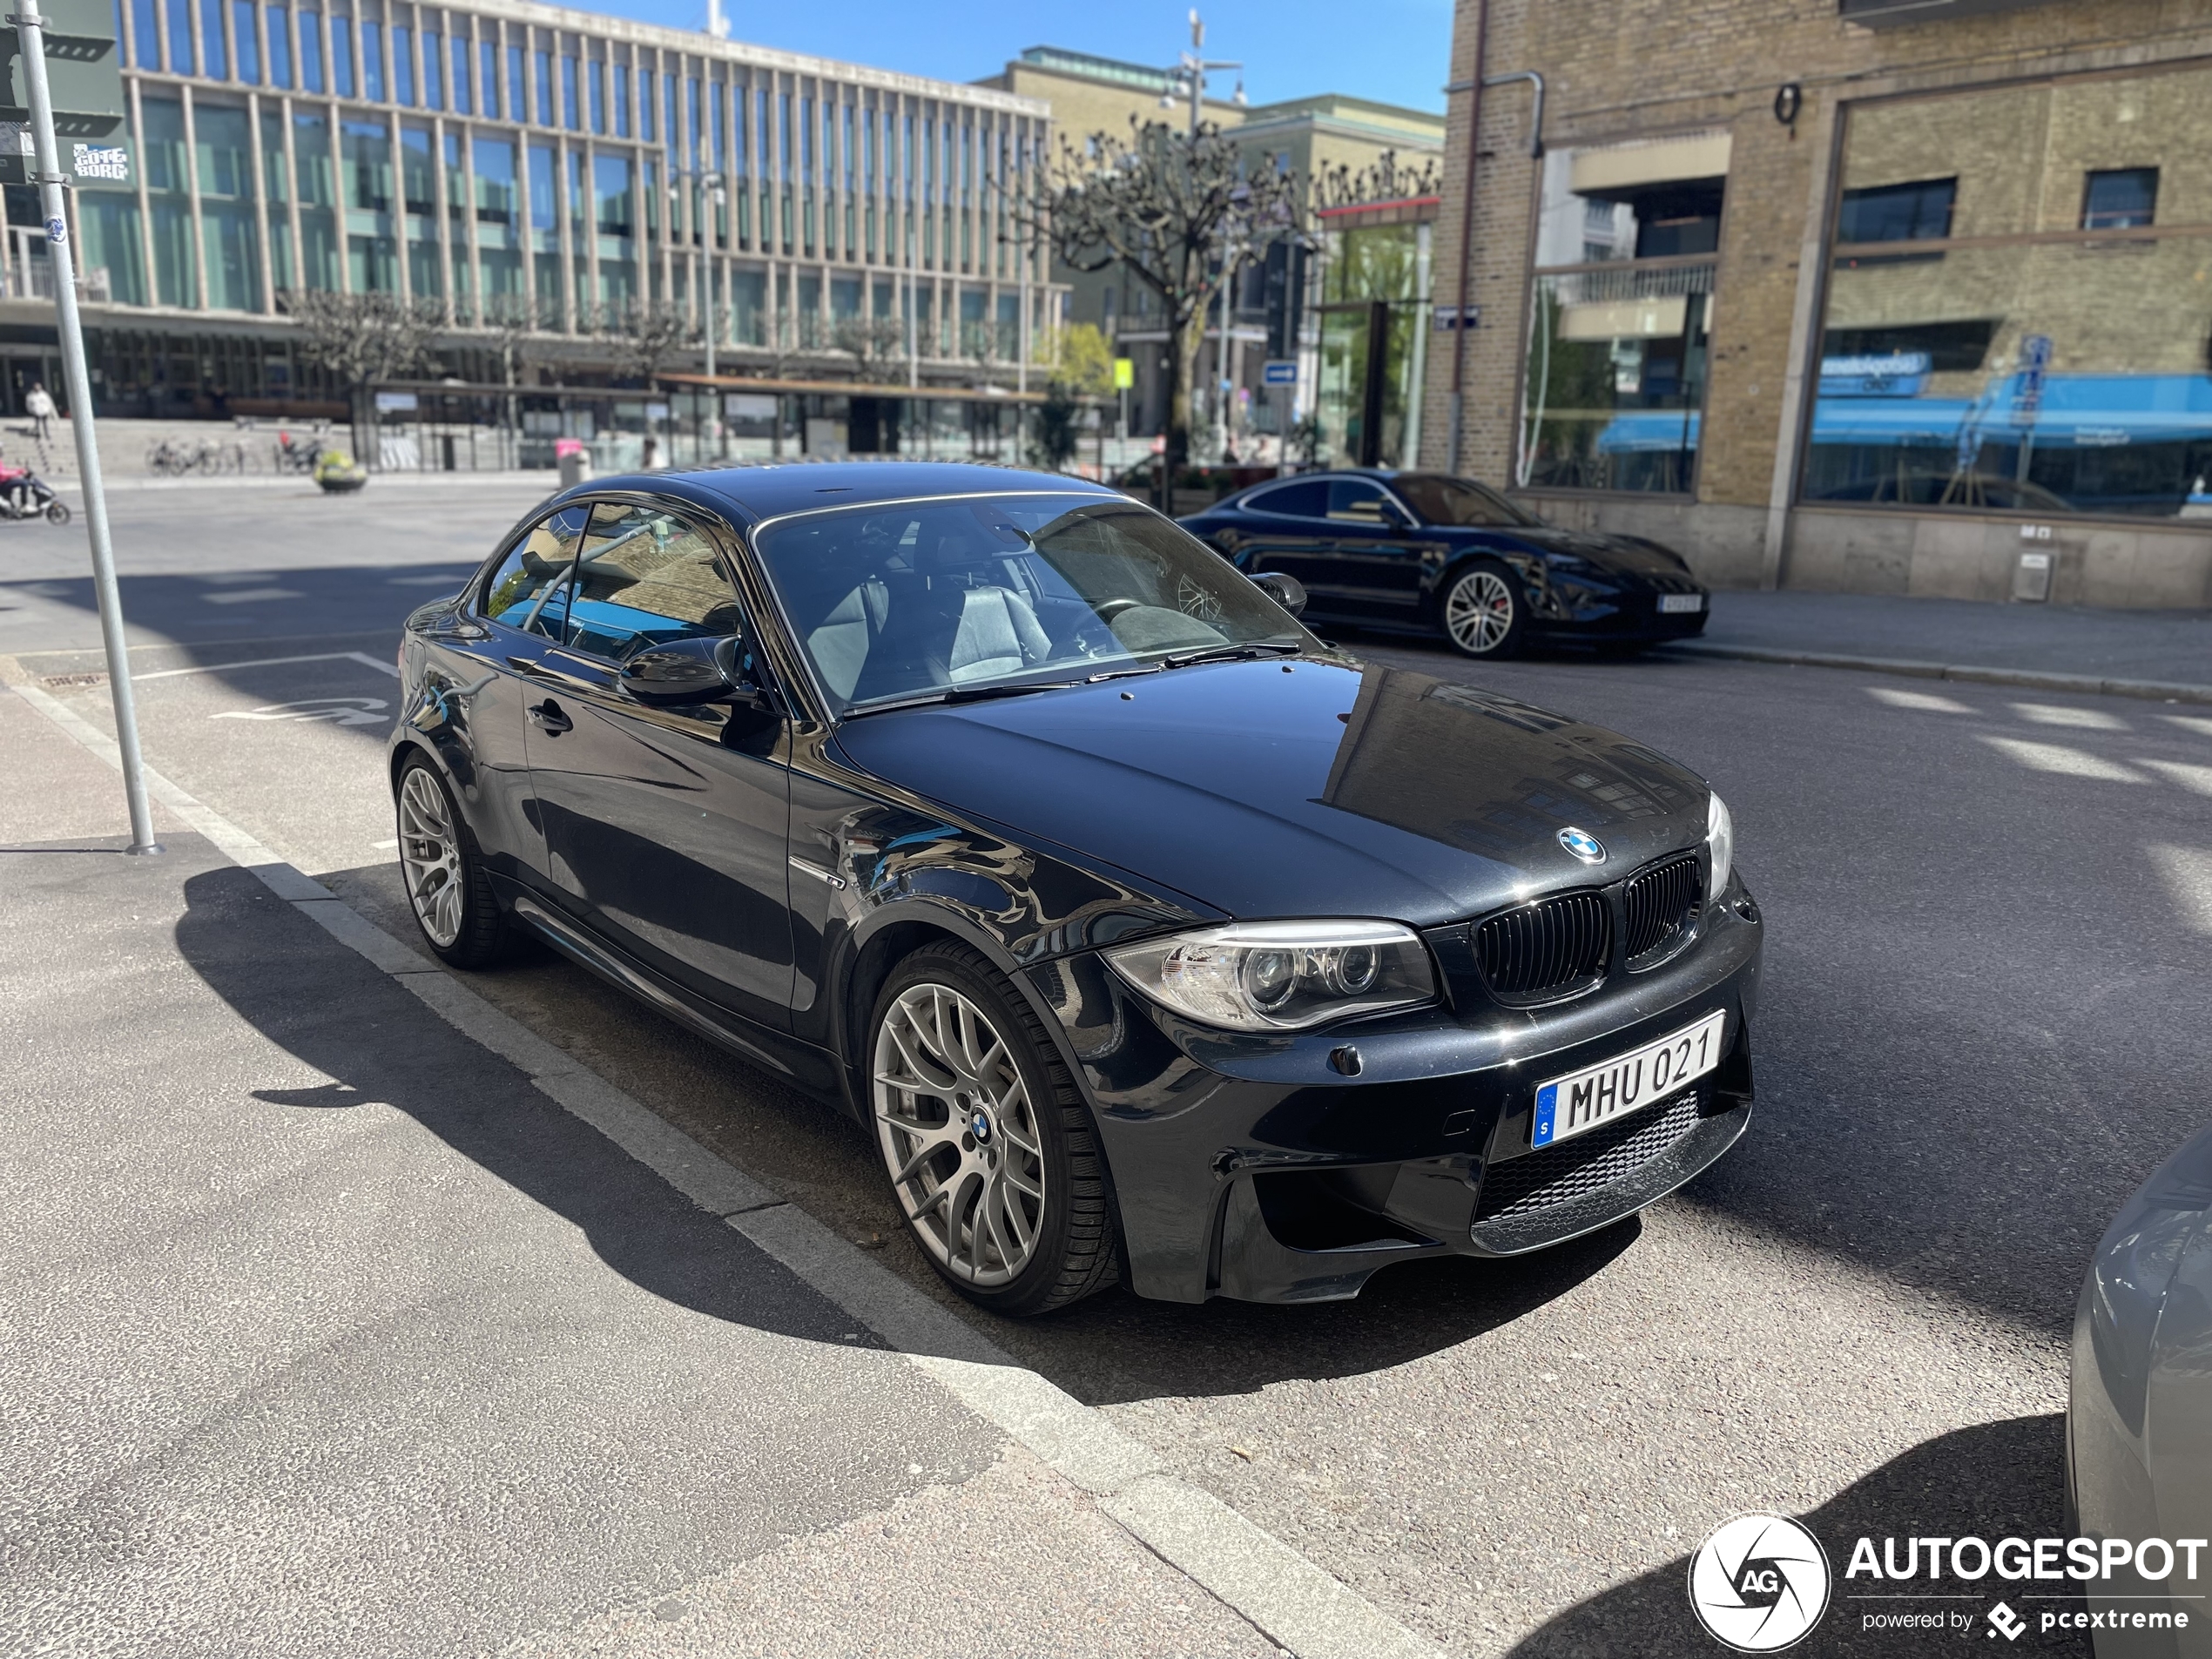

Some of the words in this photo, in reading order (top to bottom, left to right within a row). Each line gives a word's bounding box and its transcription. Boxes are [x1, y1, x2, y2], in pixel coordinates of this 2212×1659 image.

[78, 163, 125, 180] BORG
[1568, 1058, 1643, 1130] MHU
[1652, 1025, 1710, 1093] 021
[1540, 1122, 1549, 1136] S
